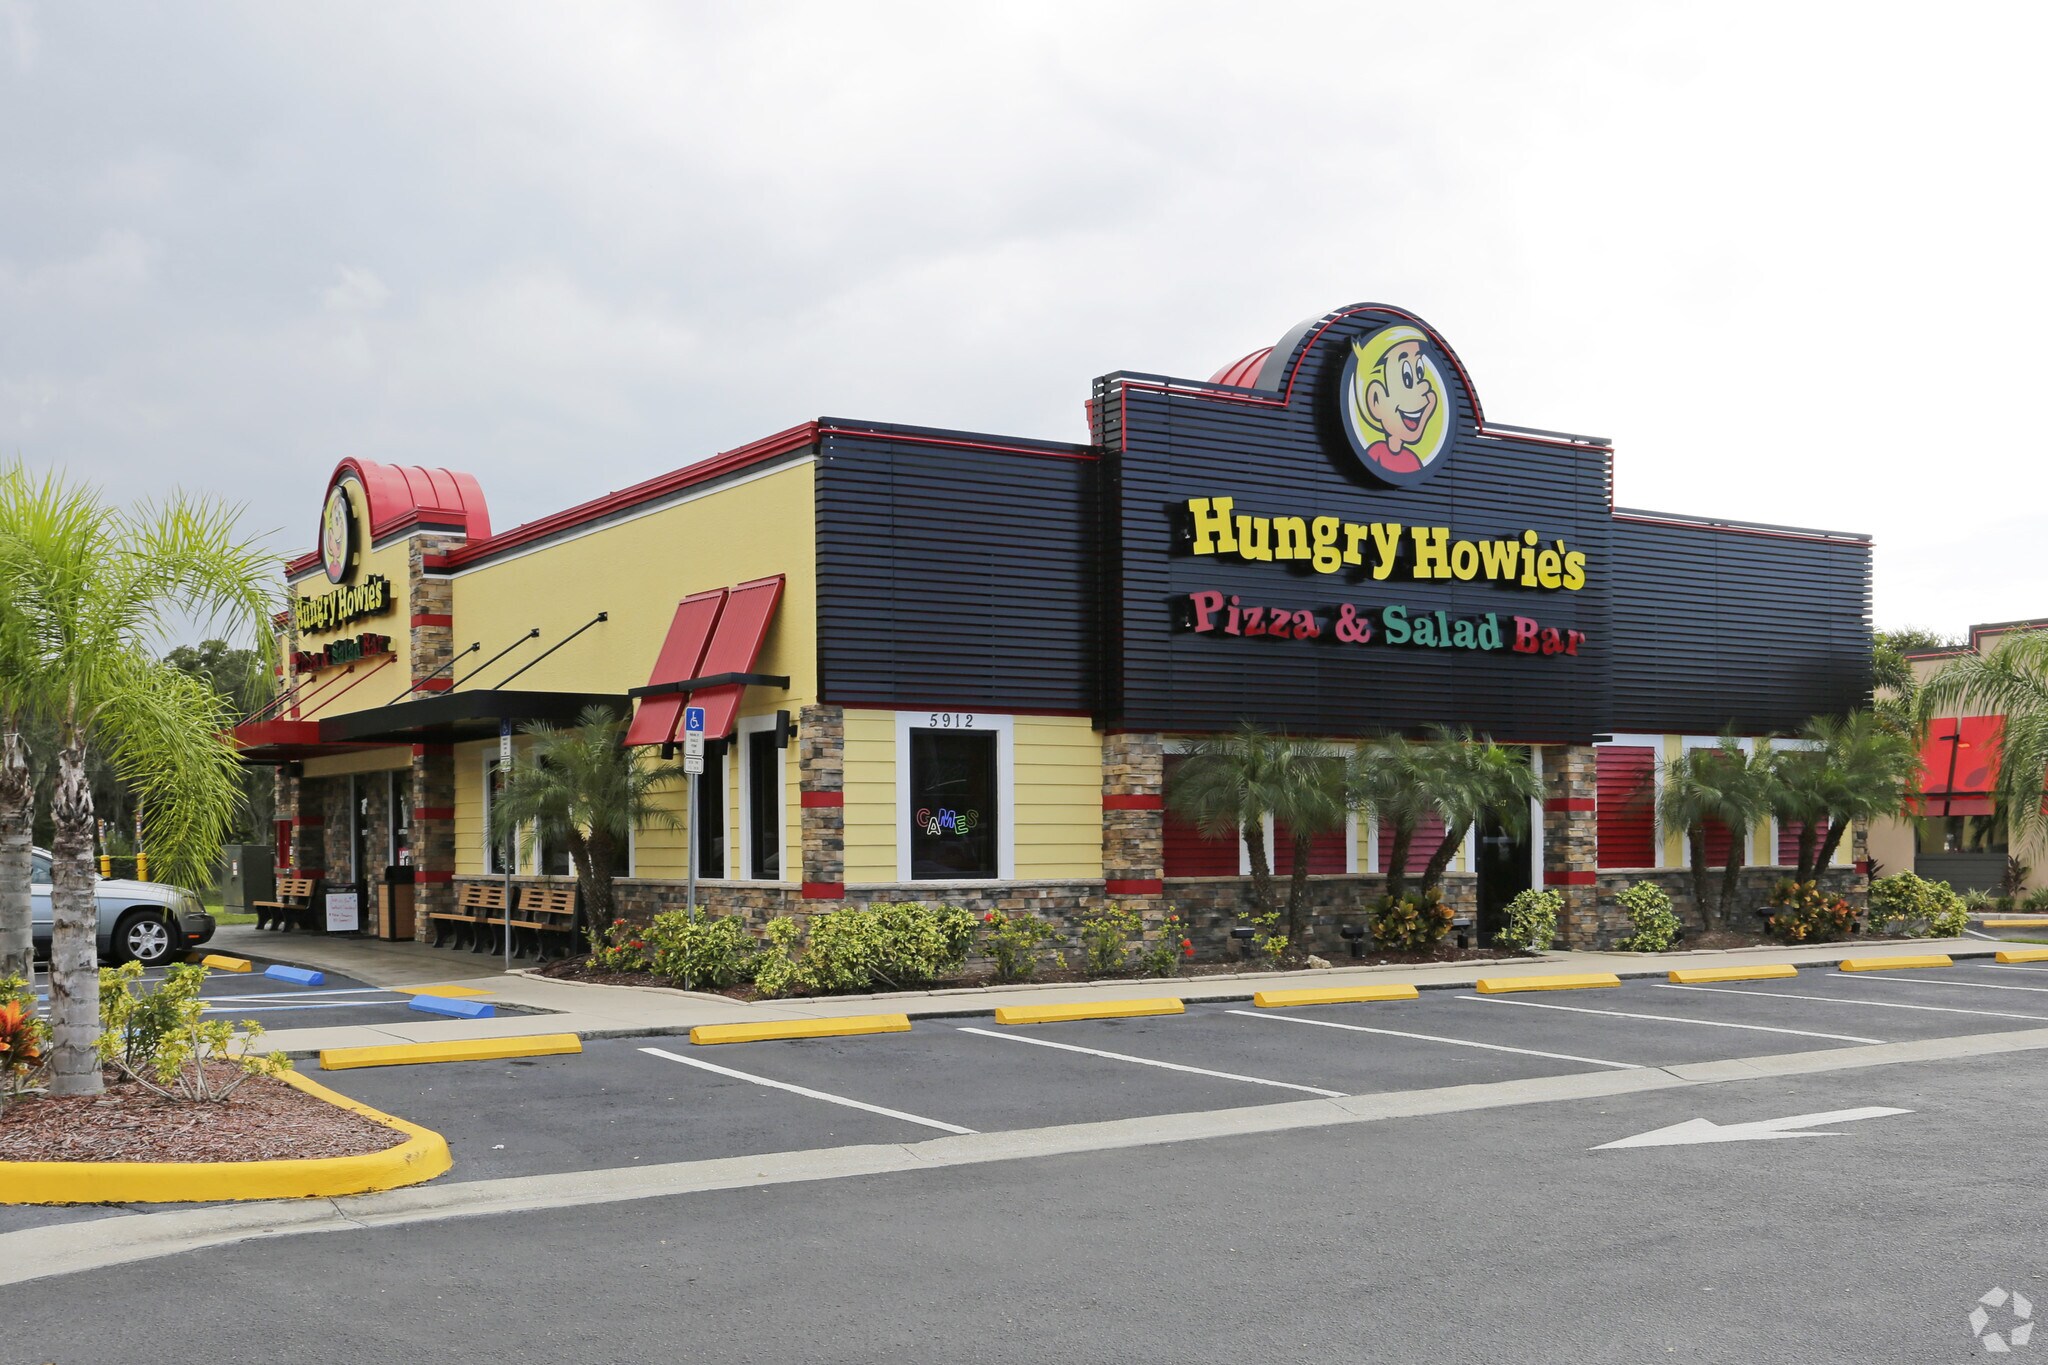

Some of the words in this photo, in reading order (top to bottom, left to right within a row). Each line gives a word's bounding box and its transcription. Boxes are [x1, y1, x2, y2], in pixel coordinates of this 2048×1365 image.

[1188, 496, 1401, 581] Hungry
[1411, 526, 1586, 591] Howie's
[295, 590, 337, 631] Hungry
[338, 574, 382, 620] Howie's
[1190, 590, 1320, 640] Pizza
[1335, 603, 1371, 644] &
[1382, 605, 1503, 651] Salad
[1512, 615, 1586, 657] Bar
[929, 713, 974, 728] 5912
